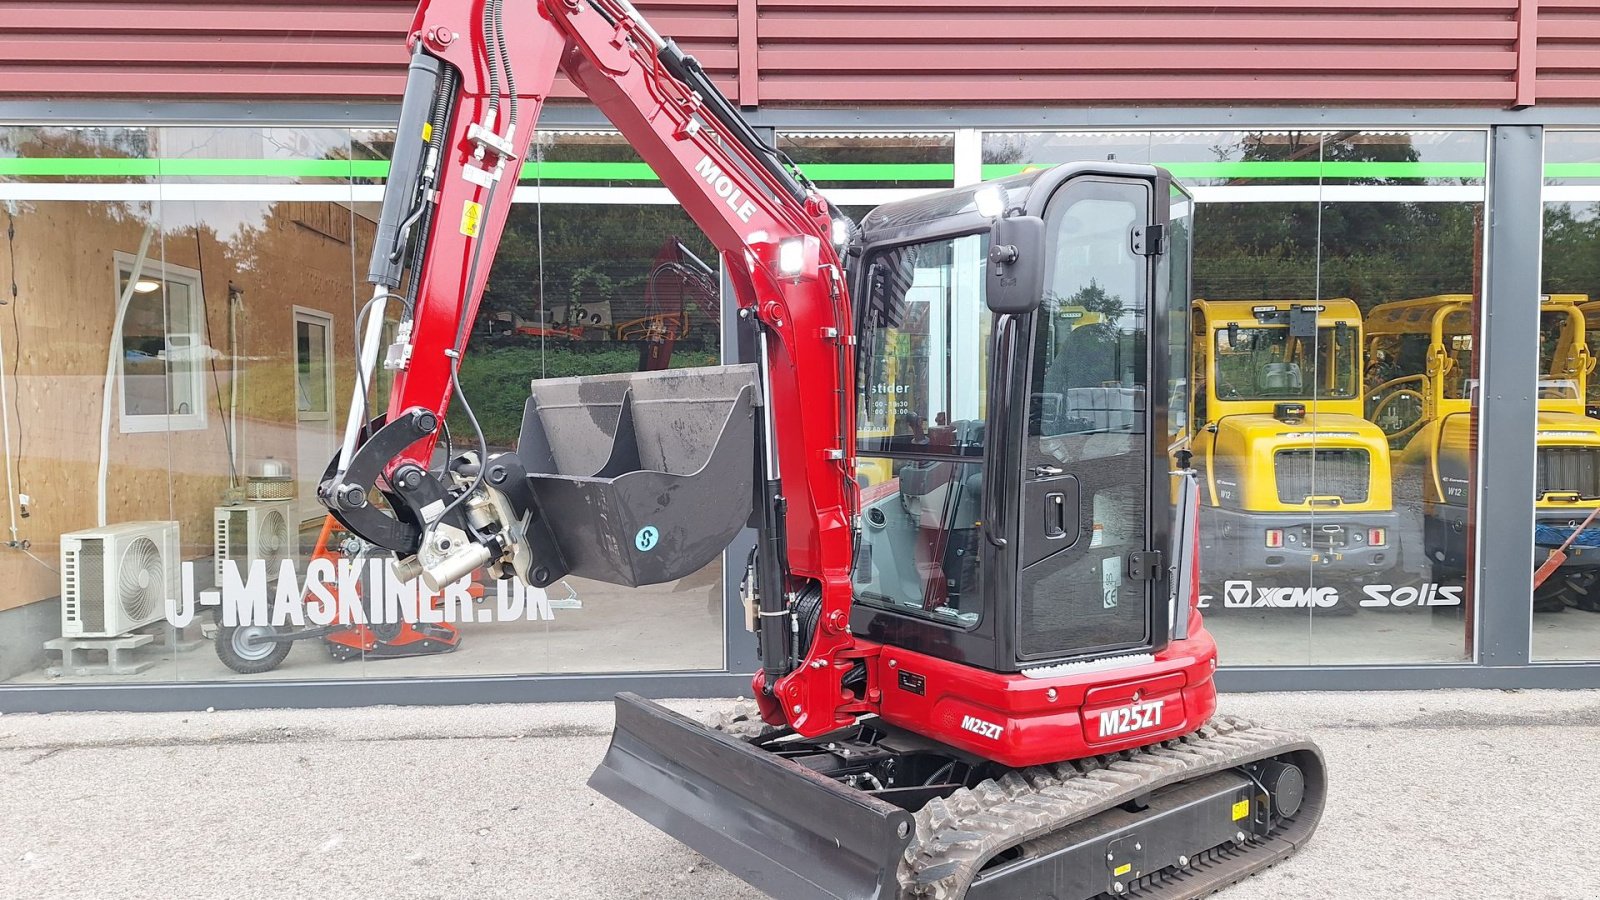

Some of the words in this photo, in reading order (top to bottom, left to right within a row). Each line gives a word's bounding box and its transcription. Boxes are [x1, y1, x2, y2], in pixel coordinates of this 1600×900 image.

[694, 155, 757, 224] MOLE
[1251, 586, 1339, 608] XCMG
[960, 715, 1004, 741] M25ZT
[1098, 700, 1165, 738] M25ZT
